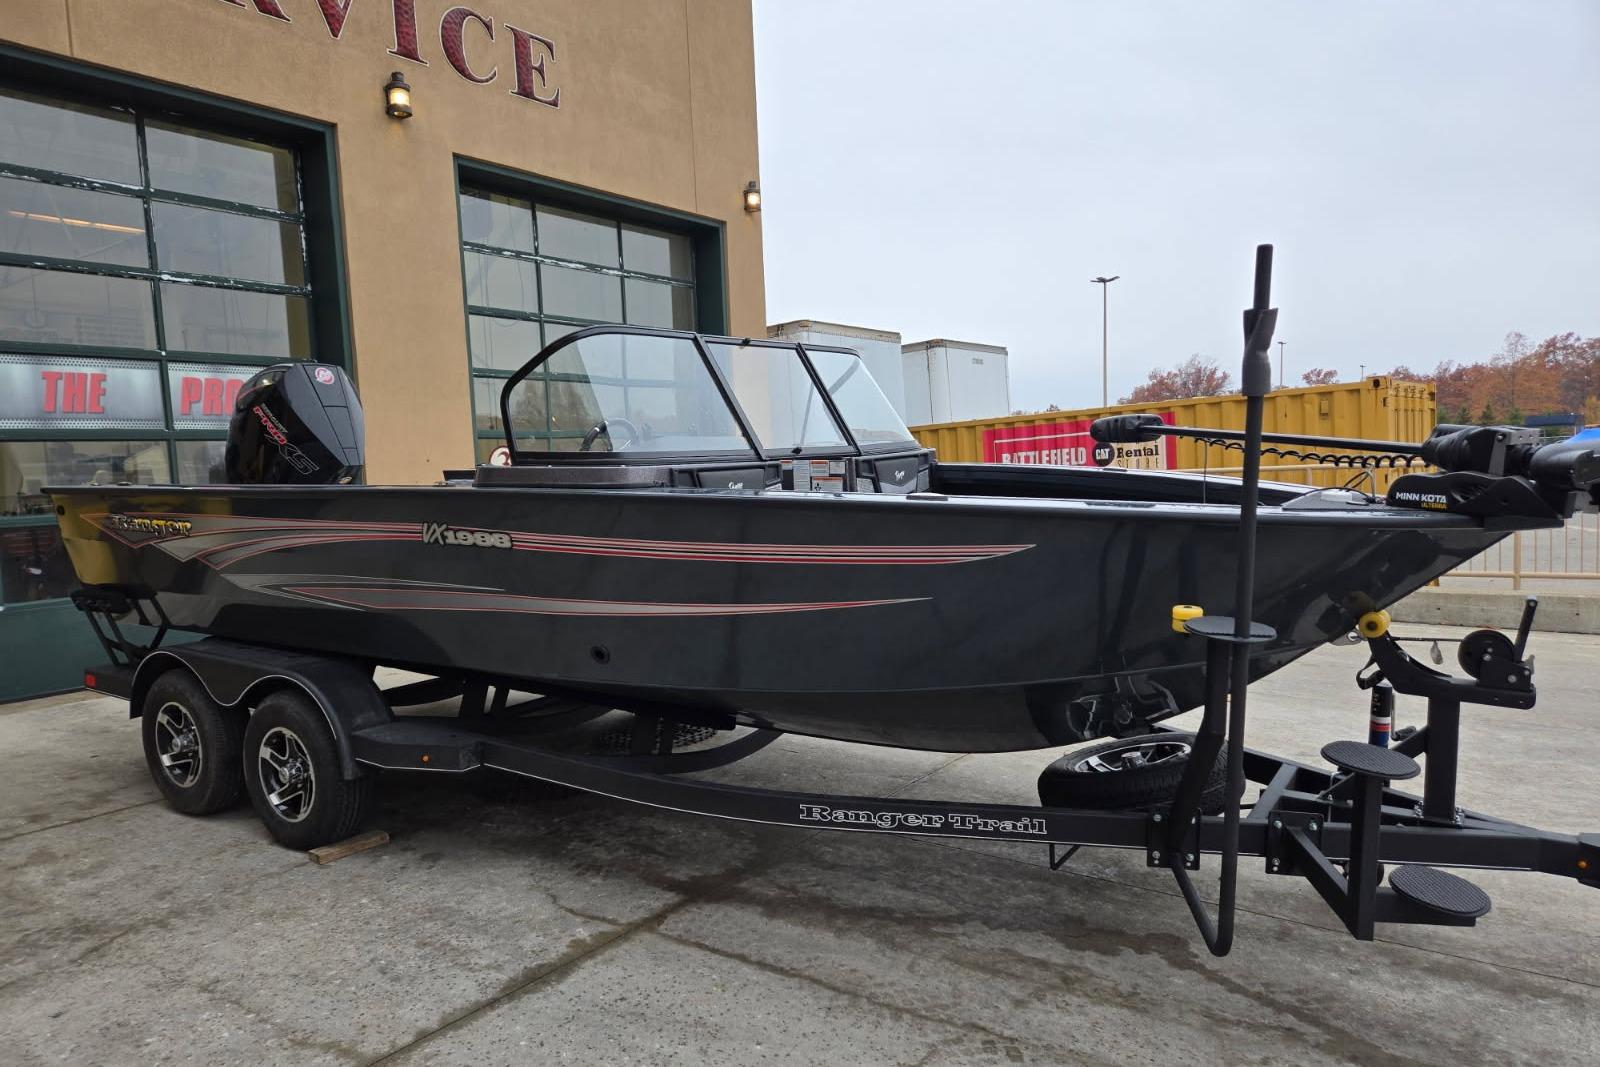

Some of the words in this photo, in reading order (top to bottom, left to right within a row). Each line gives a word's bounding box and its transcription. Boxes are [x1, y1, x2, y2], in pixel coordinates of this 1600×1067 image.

[41, 371, 107, 413] THE
[1002, 447, 1087, 465] BATTLEFIELD
[1095, 448, 1110, 460] CAT
[1116, 444, 1160, 459] Rental
[1396, 491, 1420, 501] MINN
[1421, 494, 1447, 503] KOTA
[799, 804, 945, 828] Ranger
[948, 813, 1047, 835] Trail
